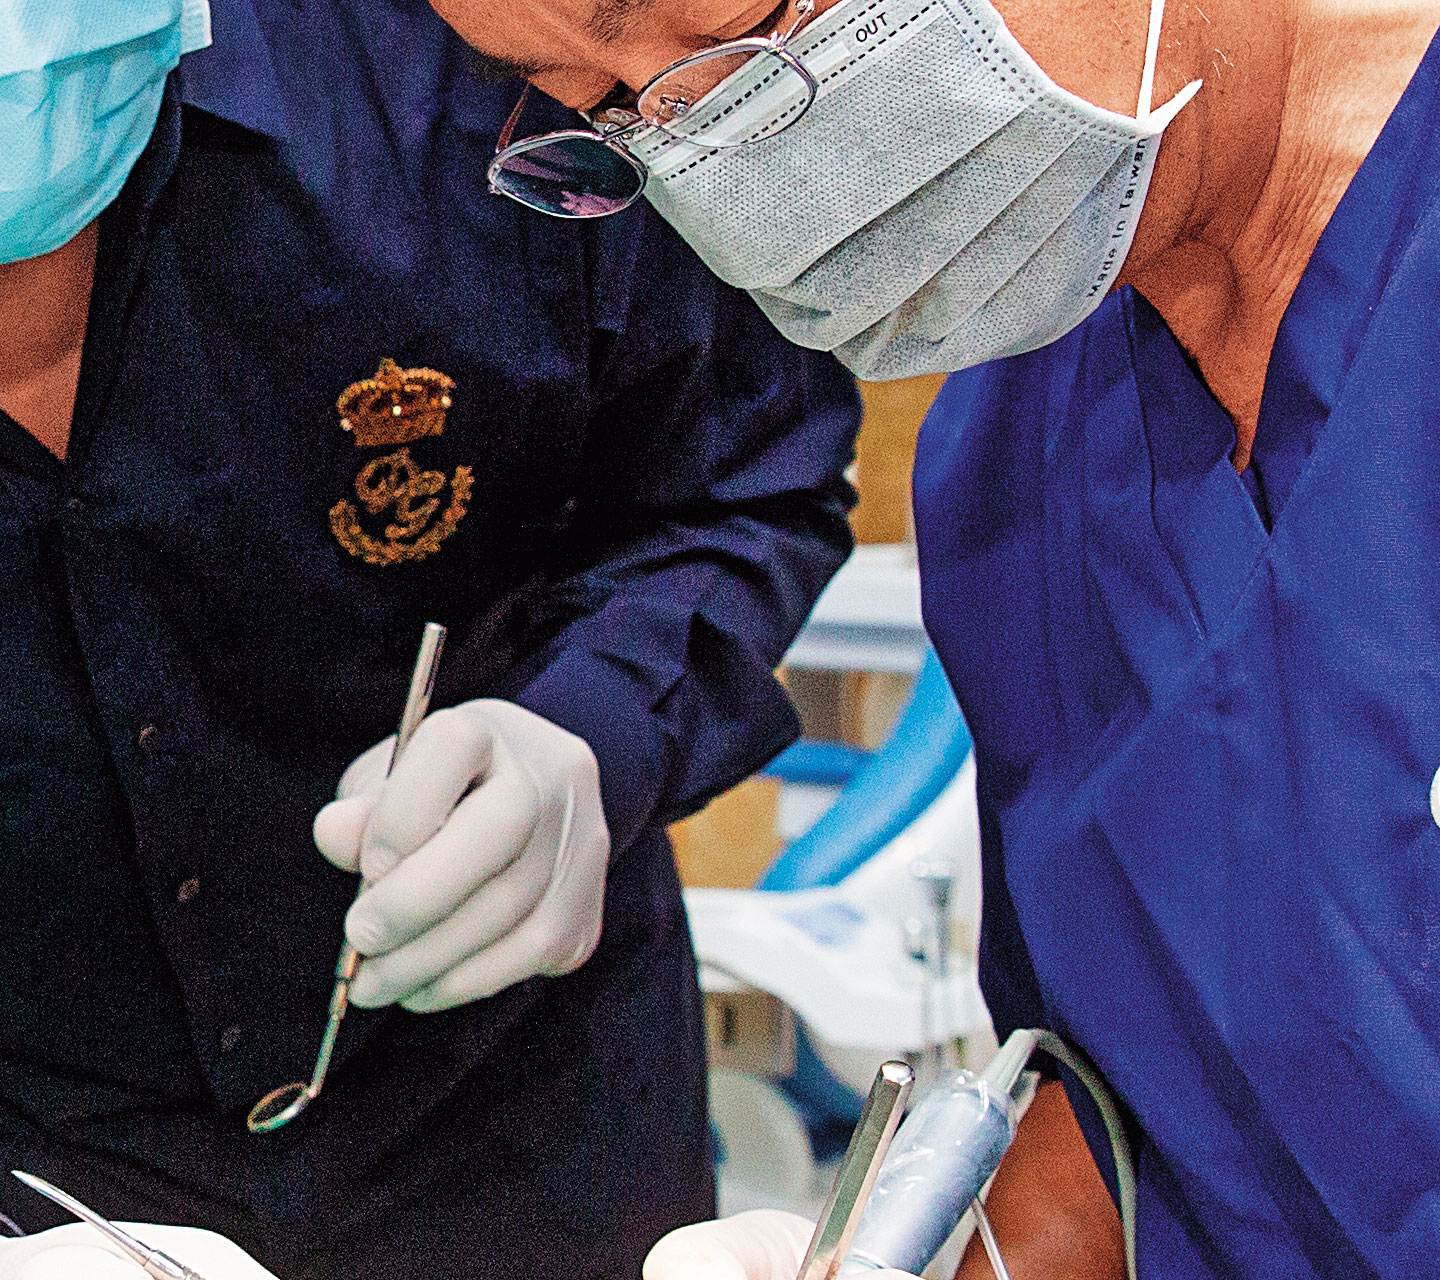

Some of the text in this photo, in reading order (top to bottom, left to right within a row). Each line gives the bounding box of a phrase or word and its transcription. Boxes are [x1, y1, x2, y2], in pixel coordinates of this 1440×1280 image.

[855, 11, 887, 43] OUT
[1086, 248, 1118, 297] Made
[1119, 137, 1149, 210] Taiwan
